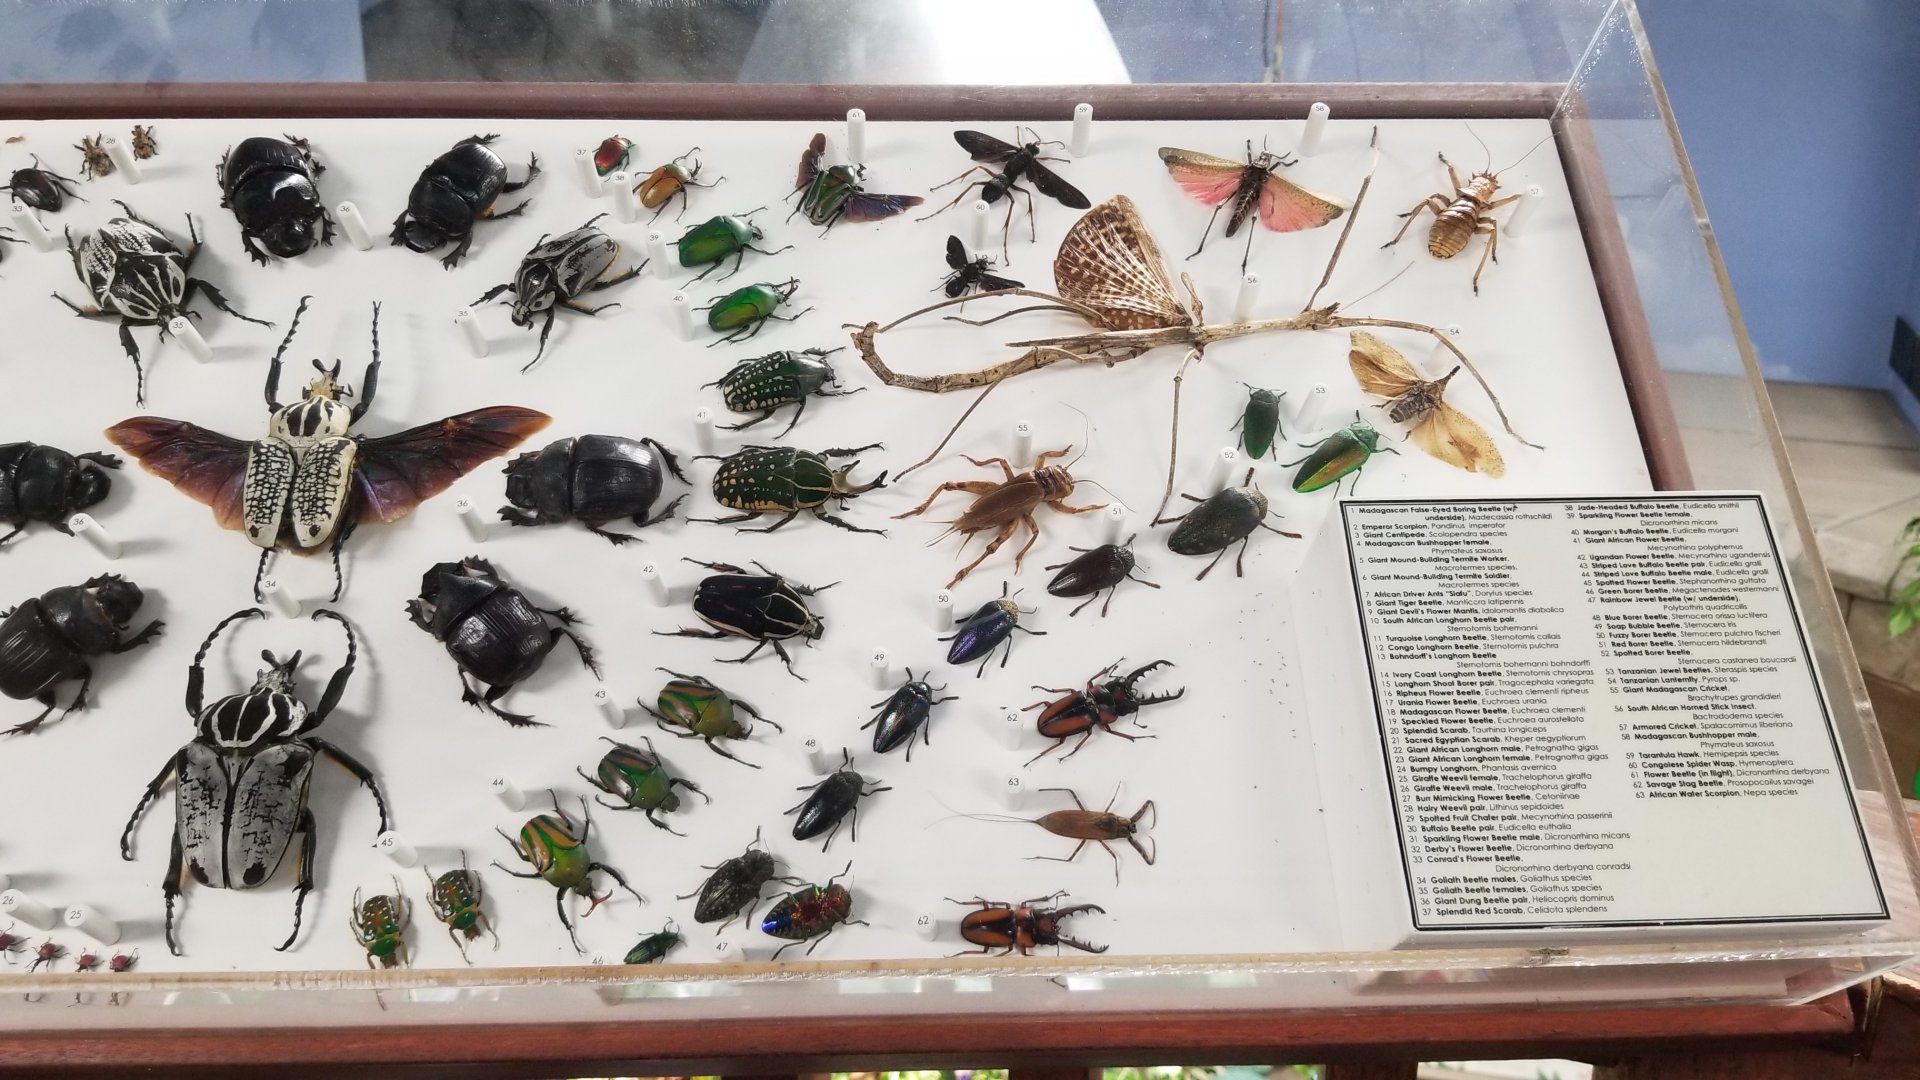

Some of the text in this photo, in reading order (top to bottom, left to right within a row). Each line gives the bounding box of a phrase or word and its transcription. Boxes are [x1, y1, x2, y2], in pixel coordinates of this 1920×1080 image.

[340, 205, 350, 213] 36
[649, 234, 659, 242] 39
[172, 321, 184, 329] 35
[1449, 328, 1460, 336] 54
[1018, 424, 1028, 432] 55
[1224, 451, 1234, 459] 52
[1112, 507, 1122, 515] 51
[73, 518, 84, 526] 36
[1361, 523, 1392, 531] Emperor
[1428, 530, 1477, 538] Scolopendra
[643, 565, 654, 573] 42
[265, 580, 276, 588] 34
[938, 594, 949, 603] 50
[1606, 622, 1626, 630] Soap
[874, 653, 885, 661] 49
[1619, 676, 1659, 684] Tanzanian
[594, 690, 606, 699] 43
[1397, 698, 1423, 706] Urania
[1006, 713, 1018, 722] 62
[1402, 726, 1438, 735] Splendid
[1507, 725, 1547, 733] longiceps
[805, 738, 816, 748] 48
[1391, 736, 1399, 744] 21
[1434, 736, 1470, 744] Egyptian
[1504, 735, 1533, 743] Kheper
[1460, 745, 1498, 753] Longhorn
[1525, 744, 1575, 752] Petrognatha
[1577, 743, 1599, 752] gigas
[1625, 751, 1634, 759] 59
[1638, 751, 1676, 759] Tarantula
[1749, 748, 1779, 757] species
[1409, 765, 1437, 773] Bumpy
[1481, 763, 1519, 771] Phantasis
[1641, 760, 1684, 769] Congolese
[1685, 760, 1711, 768] Spider
[1738, 758, 1794, 767] Hymenoptera
[1398, 774, 1408, 782] 25
[1411, 774, 1438, 782] Giraffe
[1501, 772, 1564, 781] Trachelophorus
[1565, 771, 1592, 780] giraffa
[492, 778, 504, 786] 44
[1008, 777, 1019, 786] 63
[1648, 790, 1678, 798] African
[1743, 789, 1766, 797] Nepa
[1767, 787, 1798, 796] species
[1401, 794, 1410, 802] 27
[1415, 794, 1430, 802] Burr
[1432, 794, 1475, 802] Mimicking
[1476, 793, 1503, 801] Flower
[381, 837, 393, 847] 45
[1416, 876, 1426, 884] 34
[1430, 875, 1461, 884] Goliath
[1462, 875, 1488, 883] Beetle
[1519, 874, 1559, 882] Goliathus
[1560, 873, 1592, 882] species
[1418, 886, 1428, 894] 35
[1432, 886, 1463, 894] Goliath
[1464, 885, 1490, 893] Beetle
[1529, 884, 1569, 892] Goliathus
[1570, 883, 1602, 892] species
[2, 895, 14, 905] 26
[1420, 897, 1430, 905] 36
[1434, 896, 1456, 905] Giant
[1458, 896, 1481, 905] Dung
[1482, 895, 1509, 904] Beetle
[1531, 894, 1577, 903] Heliocopris
[1579, 893, 1614, 902] dominus
[70, 910, 82, 920] 25
[1421, 907, 1431, 915] 37
[1435, 907, 1473, 917] Splendid
[1474, 906, 1491, 914] Red
[1526, 905, 1563, 913] Celidota
[1565, 904, 1607, 914] splendens
[917, 915, 929, 926] 62
[716, 942, 728, 952] 47
[591, 956, 604, 965] 46
